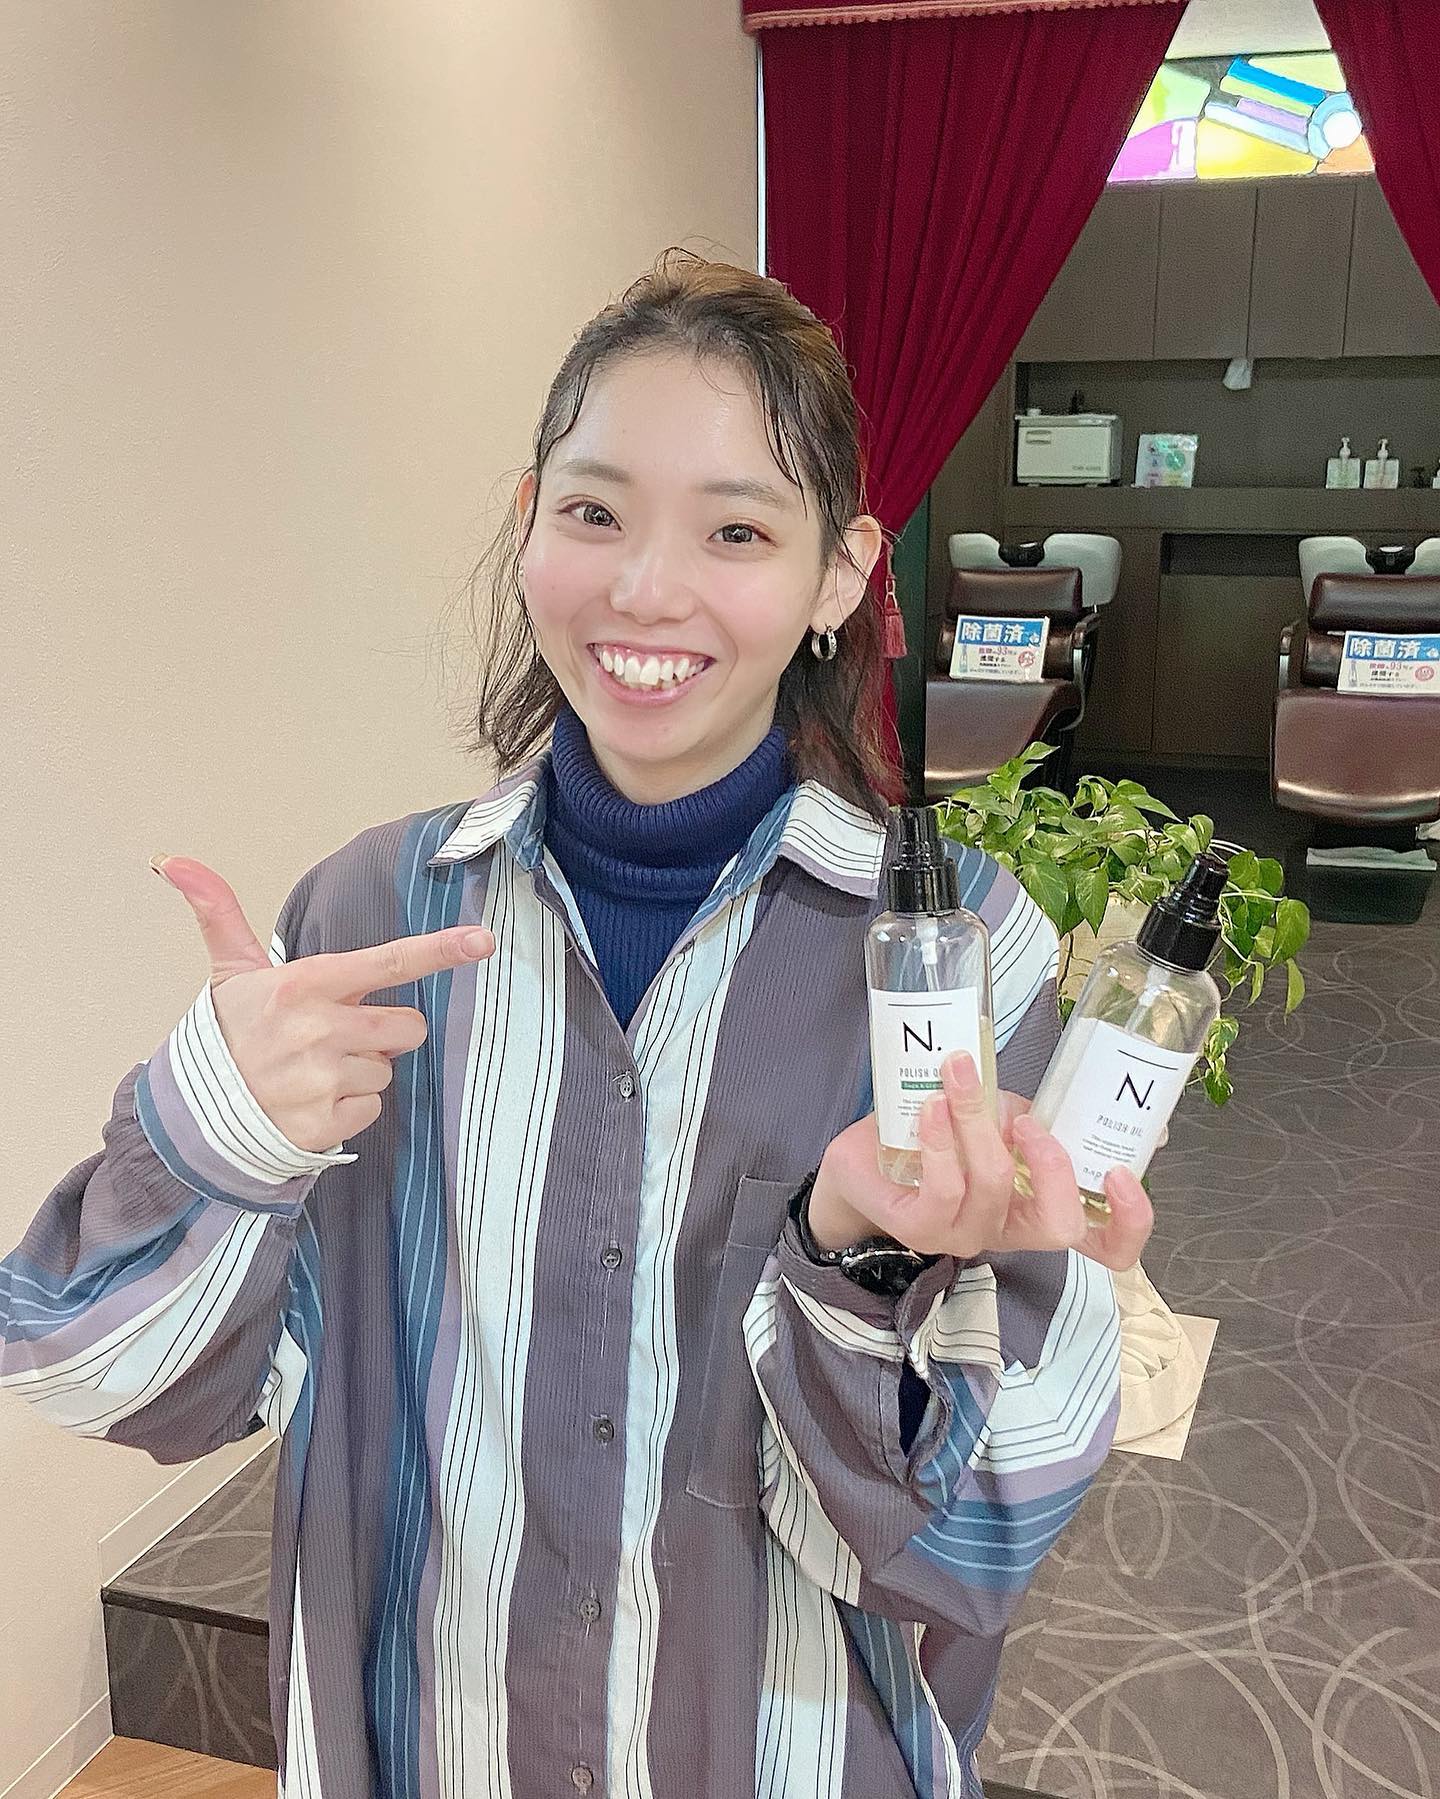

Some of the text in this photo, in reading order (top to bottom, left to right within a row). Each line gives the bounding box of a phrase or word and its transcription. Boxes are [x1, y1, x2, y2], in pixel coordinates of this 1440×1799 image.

[961, 622, 1025, 643] 除菌済
[1349, 637, 1421, 659] 除菌済
[902, 1020, 942, 1053] N.
[899, 1067, 930, 1078] POLISH
[1115, 1072, 1155, 1110] N.
[1096, 1114, 1144, 1138] POLISH OIL
